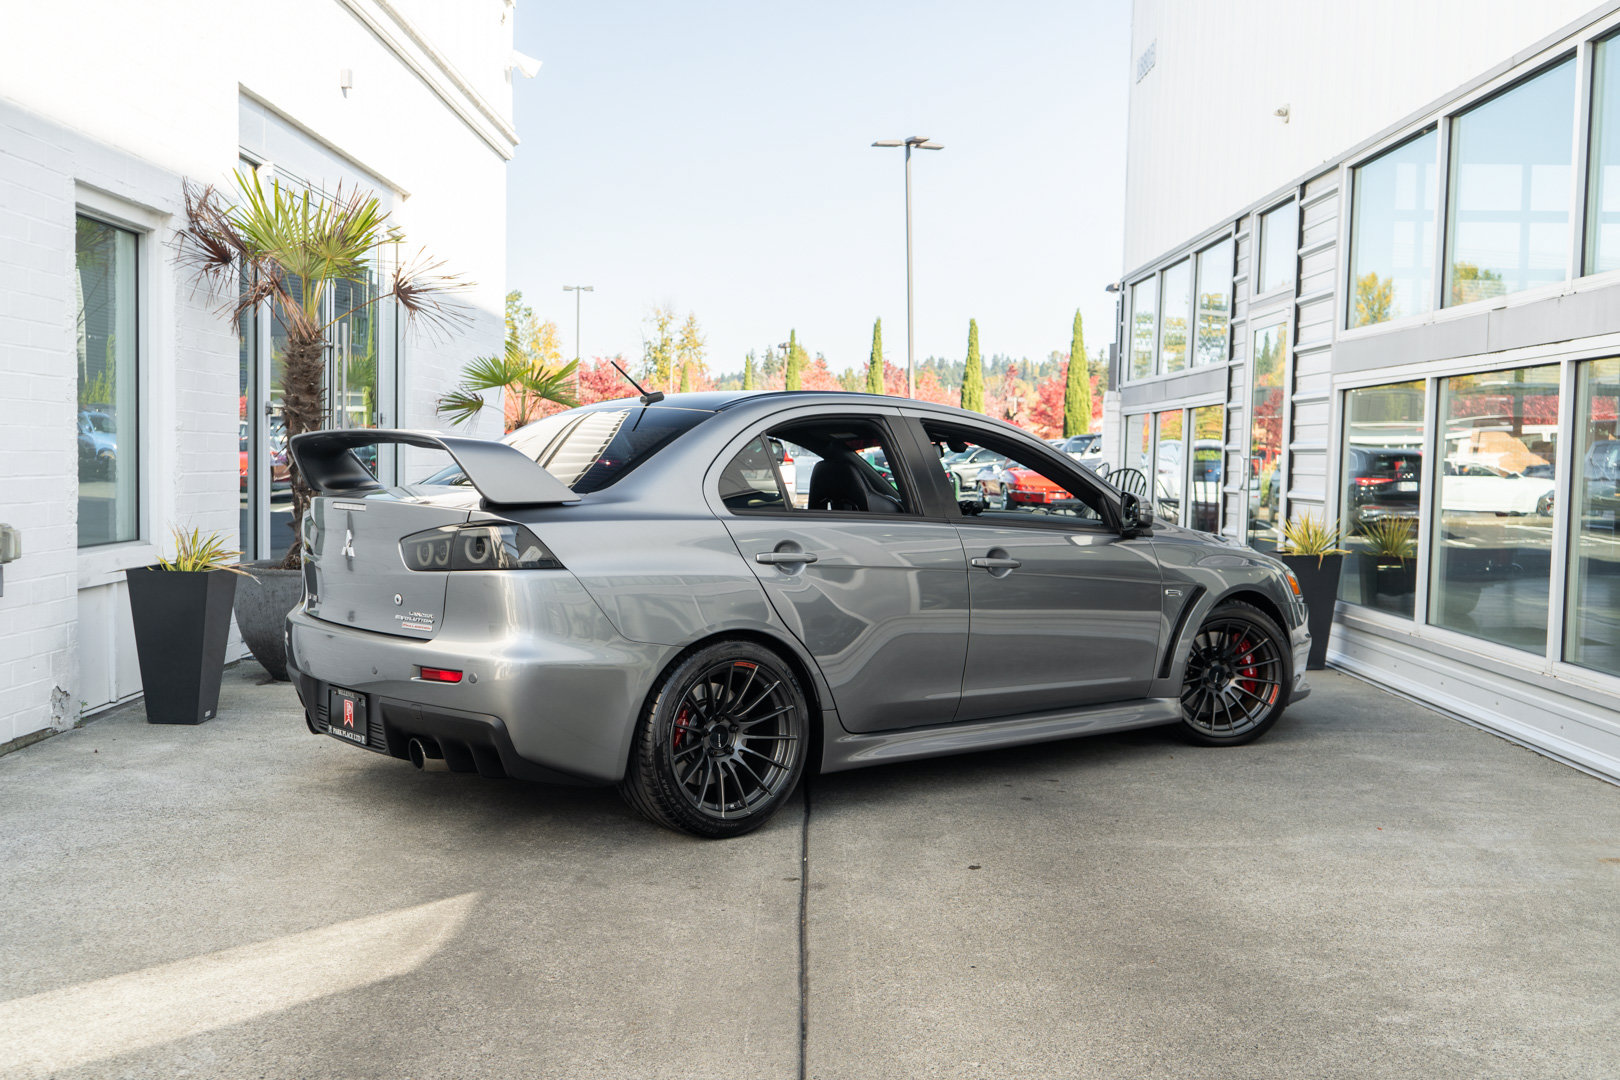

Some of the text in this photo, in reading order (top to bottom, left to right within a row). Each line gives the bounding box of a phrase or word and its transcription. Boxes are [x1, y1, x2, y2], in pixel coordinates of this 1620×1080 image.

[395, 614, 433, 623] EVOLUTION
[333, 727, 343, 736] PARK
[343, 731, 354, 739] PLACE
